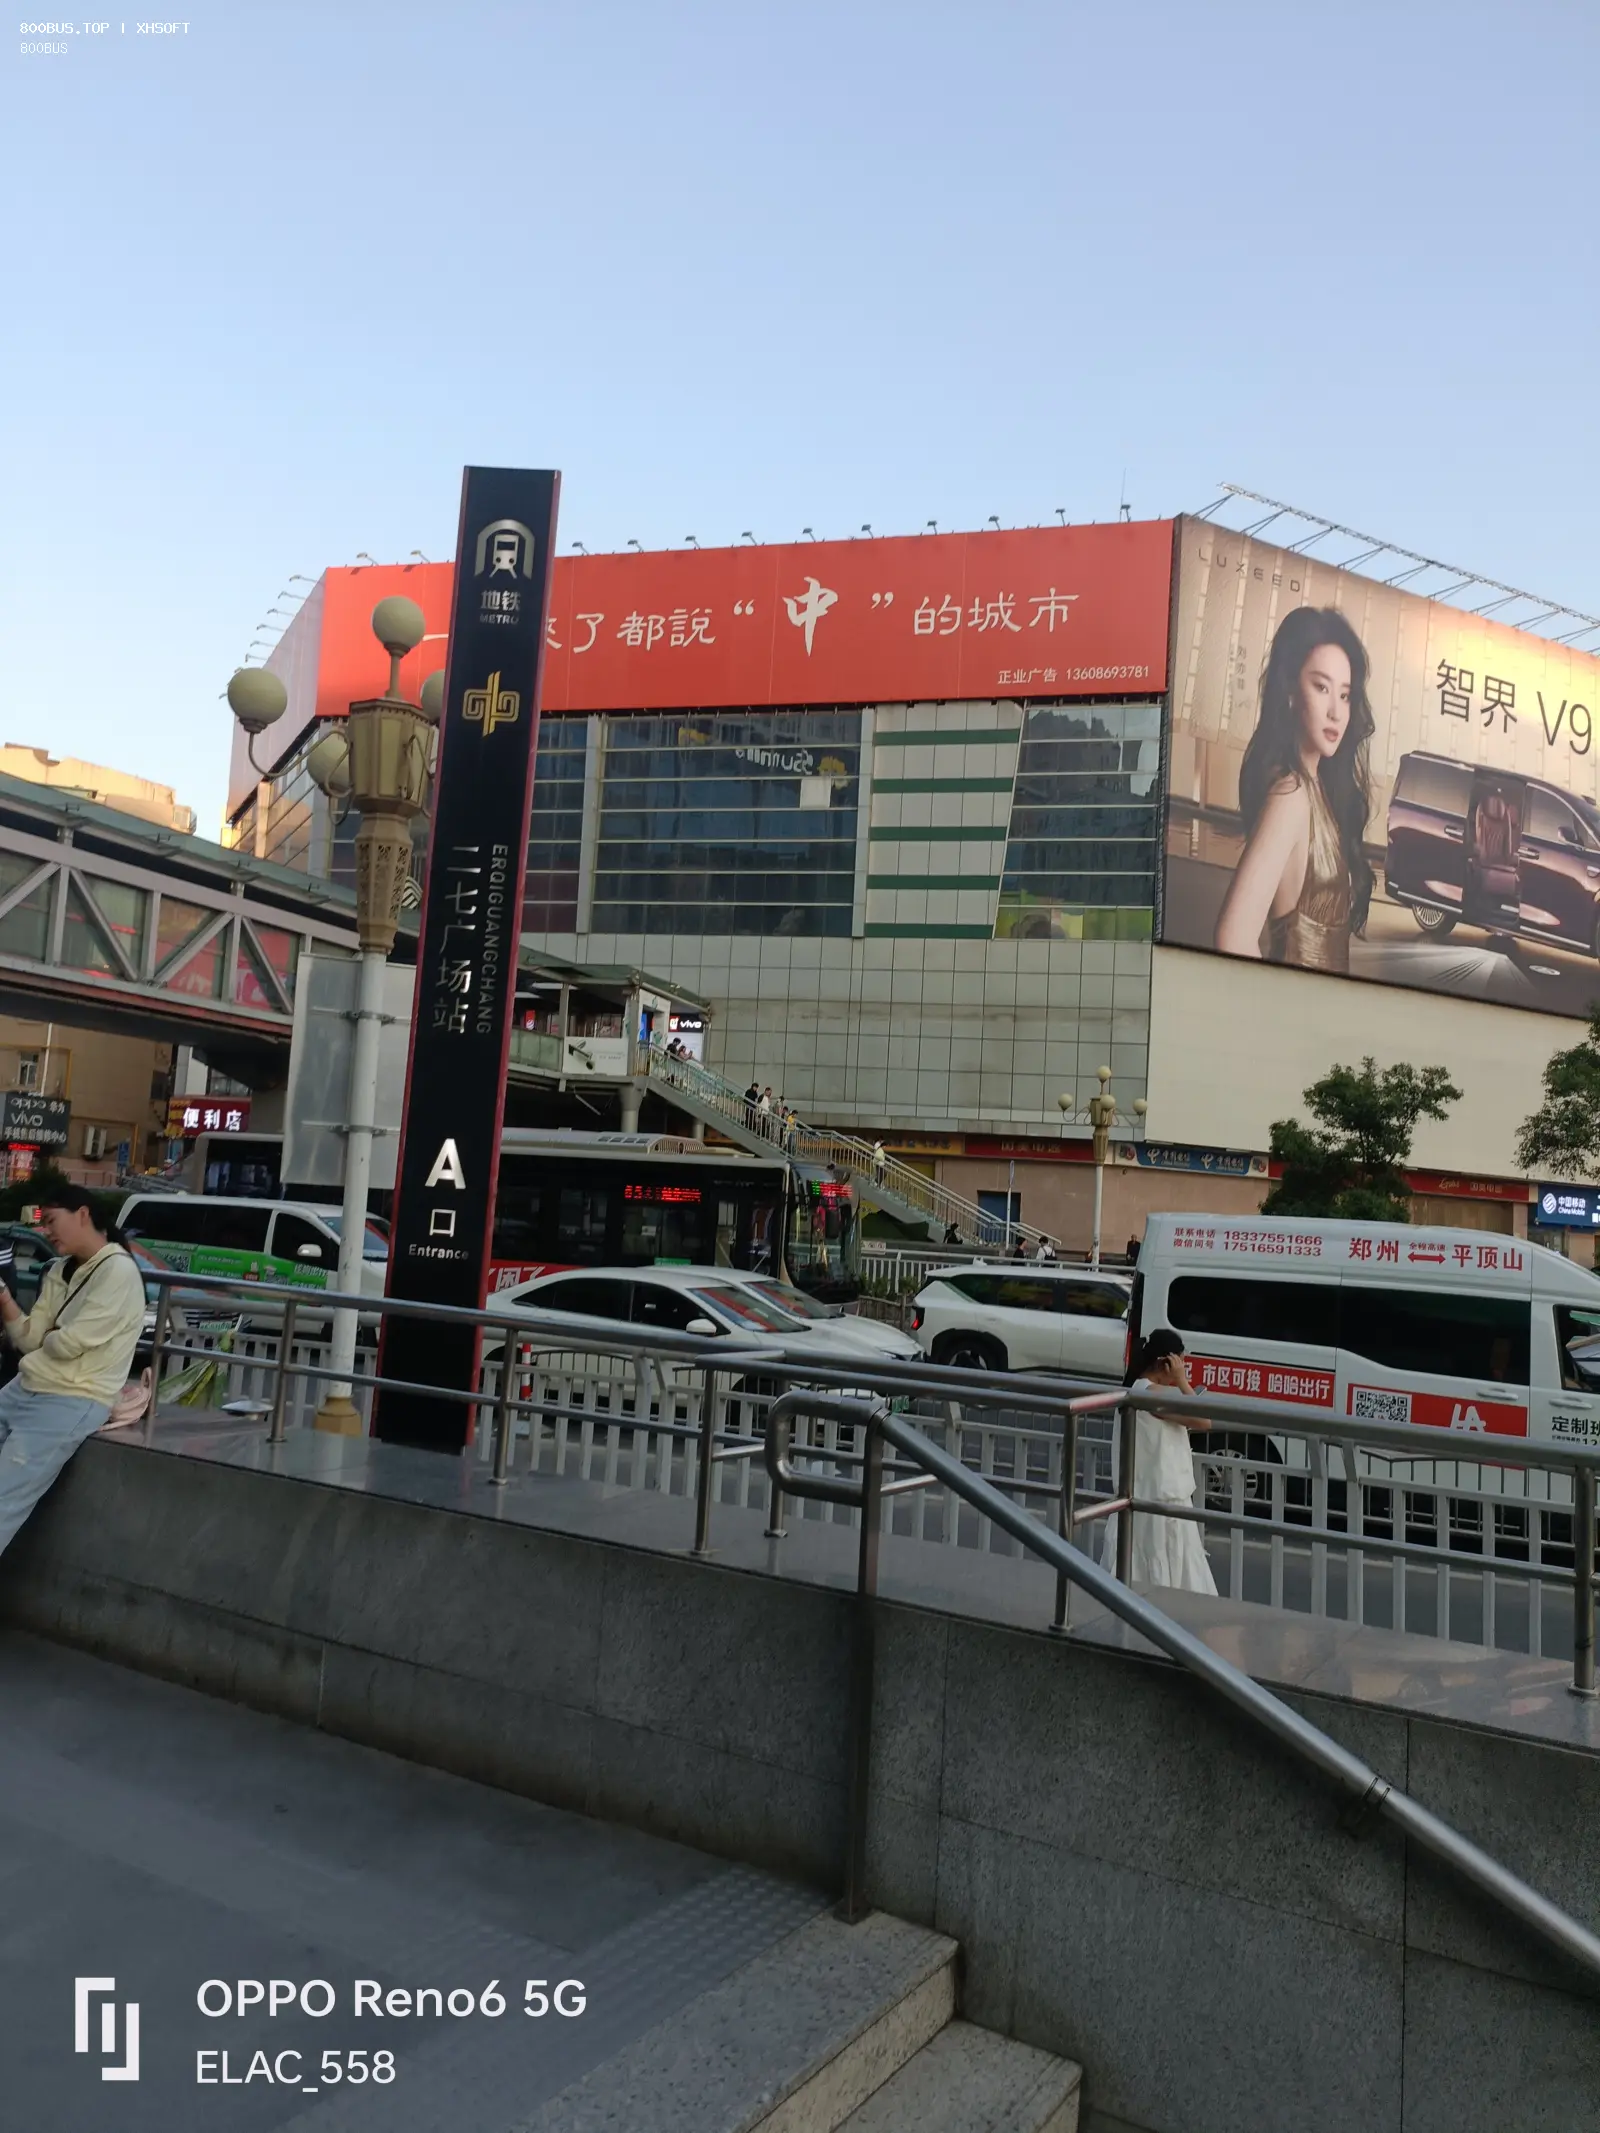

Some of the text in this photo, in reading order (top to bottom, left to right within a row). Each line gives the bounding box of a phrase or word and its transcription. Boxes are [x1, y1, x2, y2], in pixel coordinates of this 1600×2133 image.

[1198, 547, 1301, 593] LUXEED
[479, 590, 521, 612] 地铁
[479, 613, 520, 625] METRO
[997, 665, 1150, 685] 正业广告 13608693781
[1436, 657, 1594, 756] 智界 V9
[432, 846, 482, 1034] 二七广场站
[476, 844, 509, 1034] ERQIGUANGCHANG
[679, 1019, 702, 1029] vivo
[11, 1110, 43, 1127] vivo
[183, 1106, 243, 1132] 便利店
[425, 1138, 466, 1190] A
[1558, 1196, 1586, 1208] 中国移动
[1174, 1227, 1323, 1246] 联系电话 18337551666
[1408, 1242, 1447, 1252] 全程高速
[408, 1244, 469, 1260] Entrance
[1173, 1238, 1322, 1257] 微信同号 17516591333
[1348, 1237, 1523, 1272] 郑州 平顶山
[1202, 1363, 1261, 1392] 市区可接
[1267, 1372, 1331, 1400] 哈哈出行
